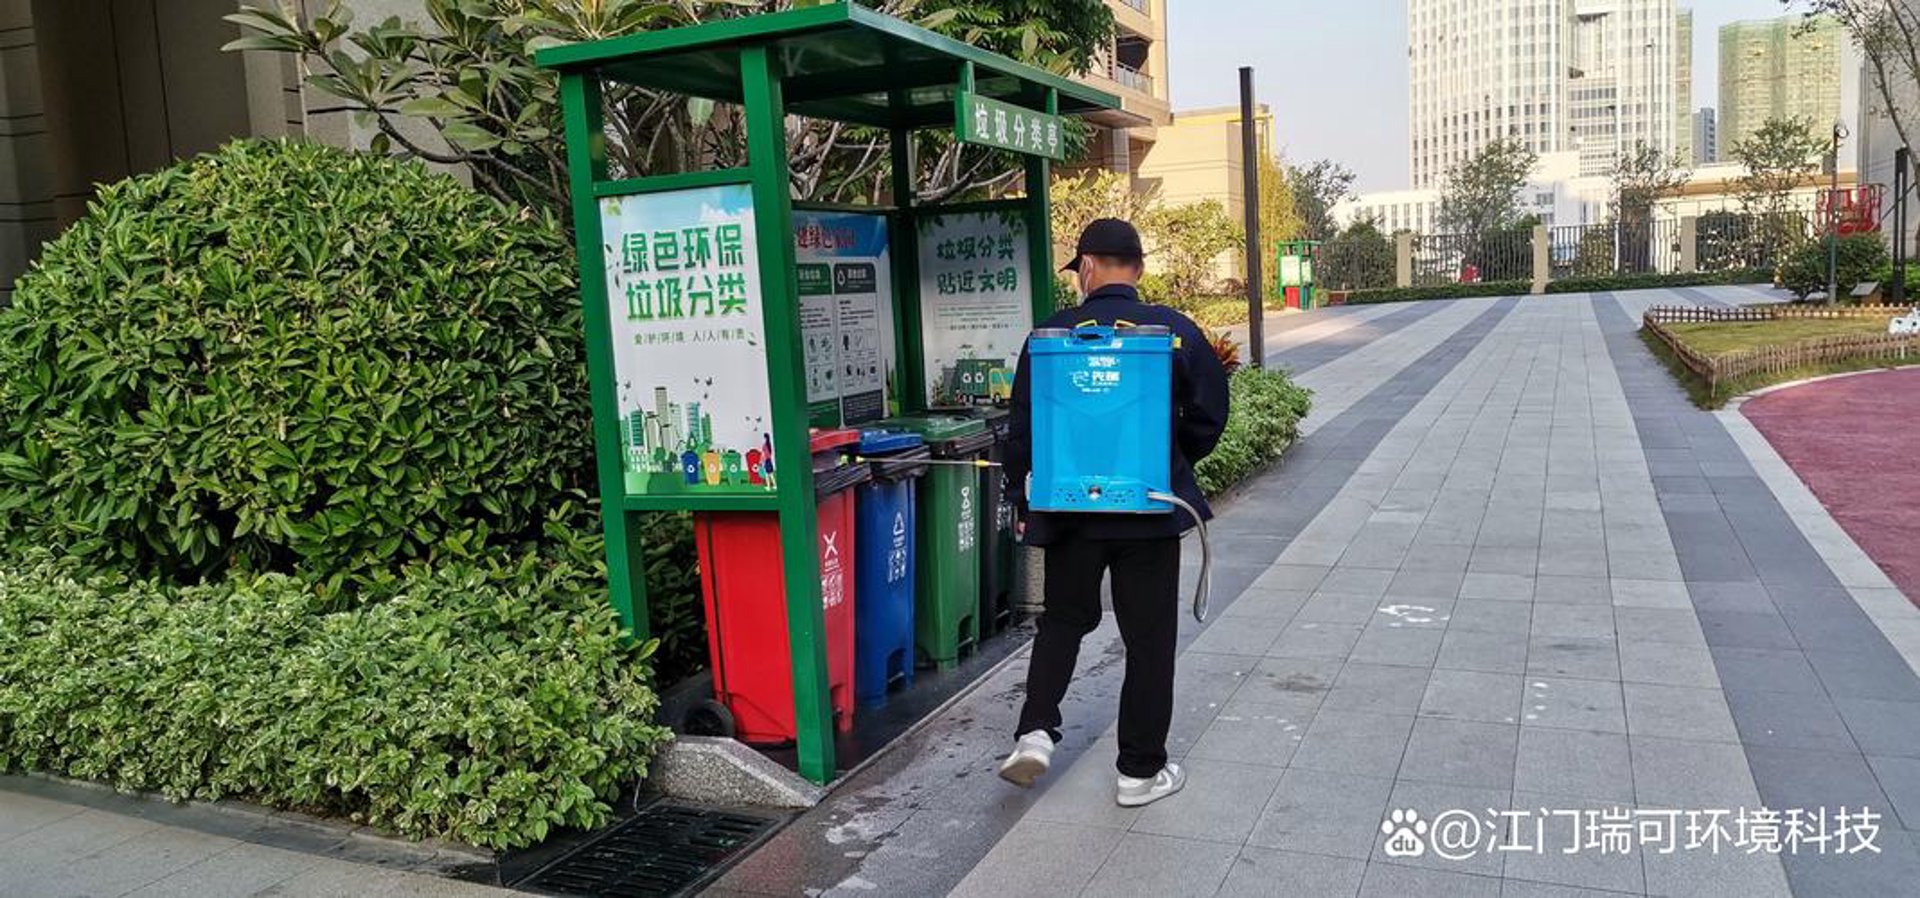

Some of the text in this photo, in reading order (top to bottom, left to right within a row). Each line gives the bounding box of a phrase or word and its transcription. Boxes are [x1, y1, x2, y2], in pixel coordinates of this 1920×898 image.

[975, 102, 1058, 155] 垃圾分类亭
[621, 224, 745, 273] 绿色环保
[936, 234, 1015, 260] 垃圾分类
[625, 273, 748, 321] 垃圾分类
[936, 266, 1017, 295] 贴近文明
